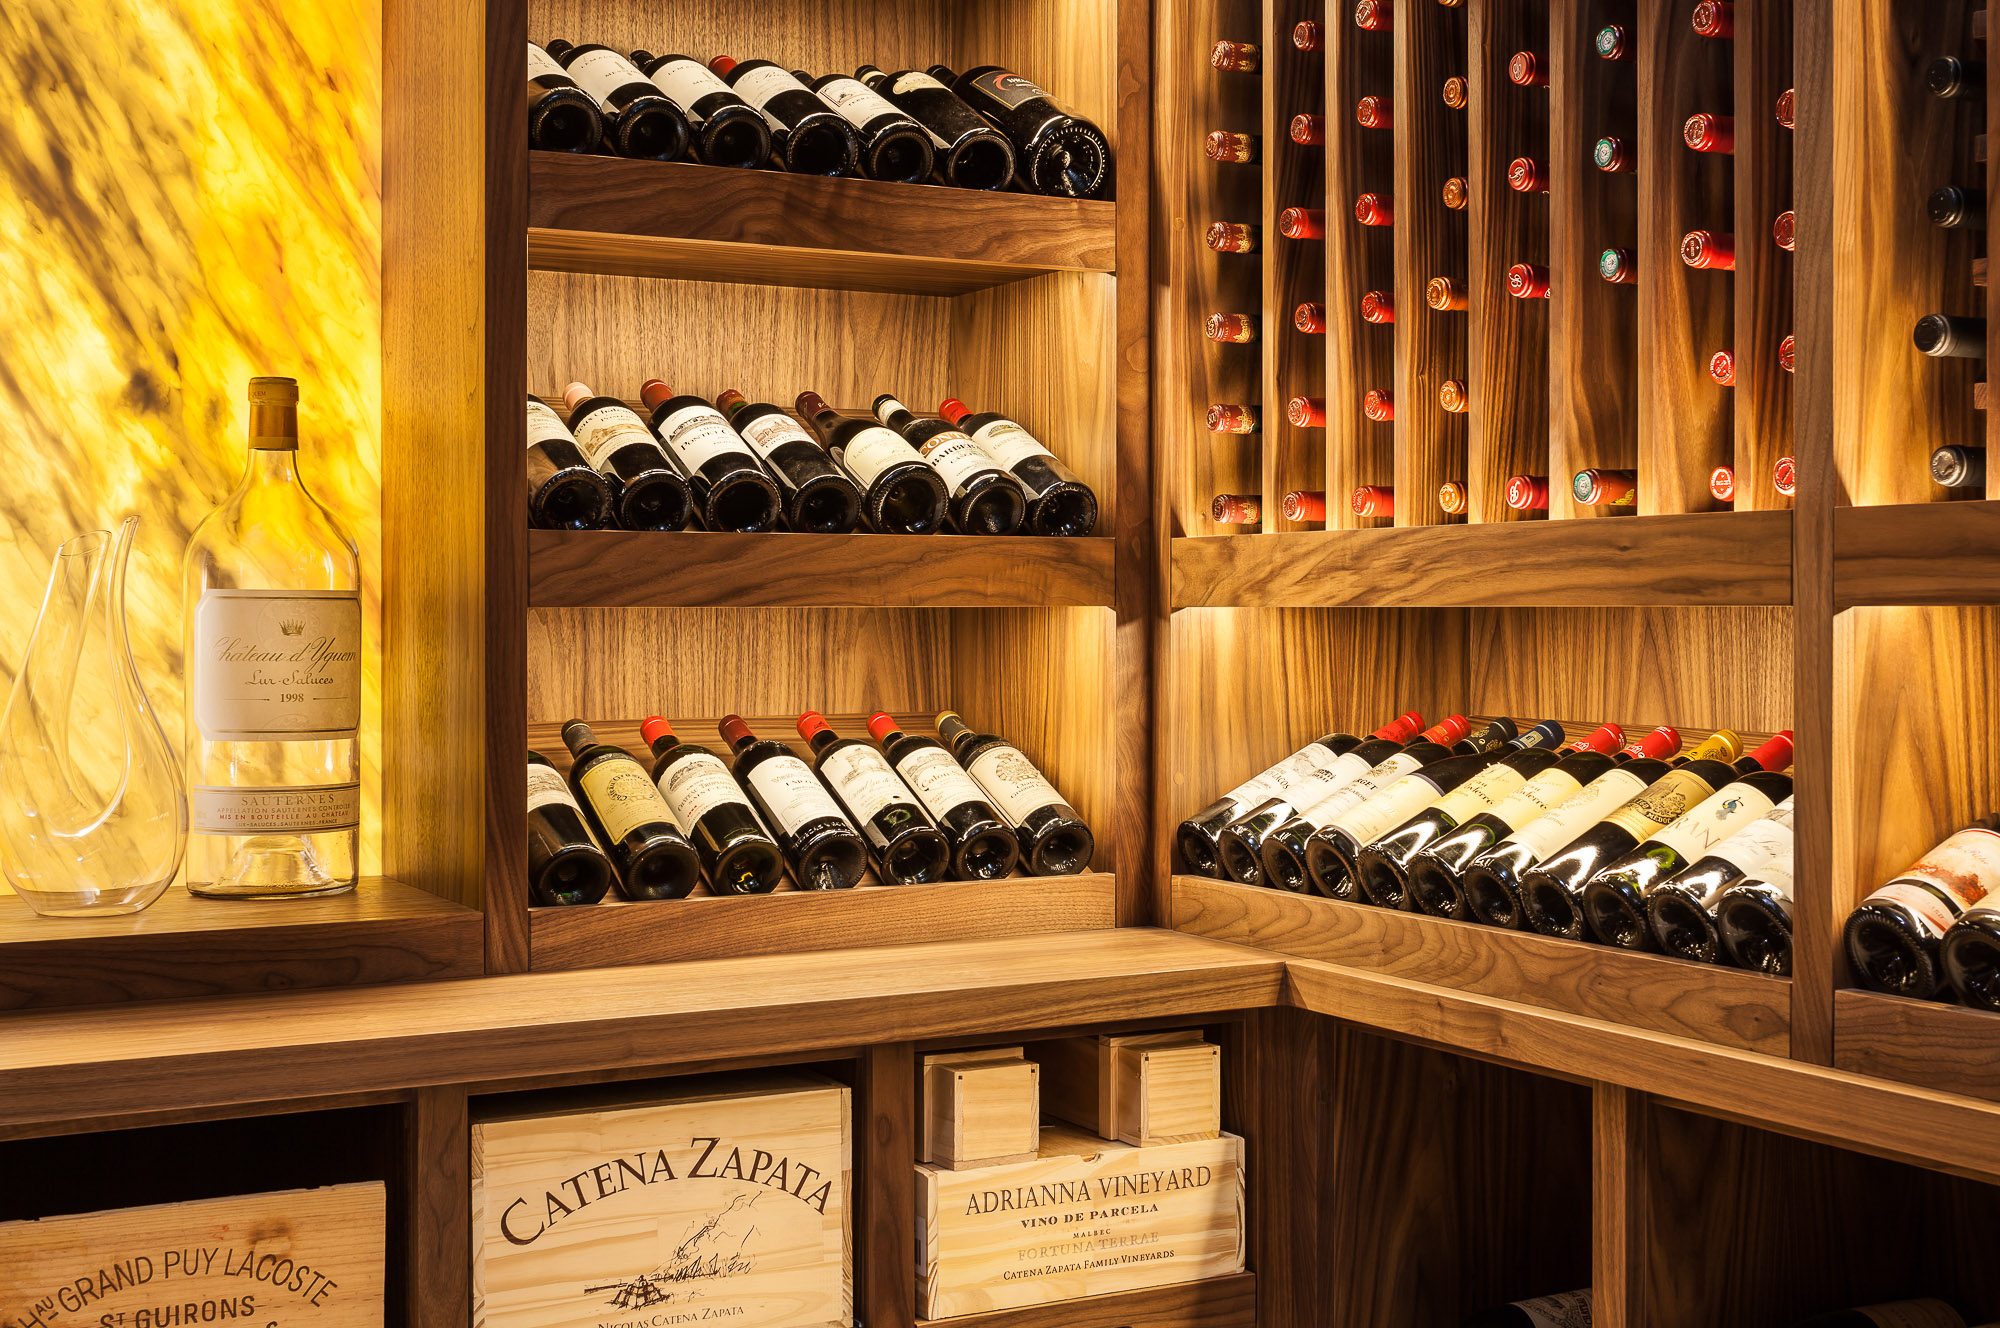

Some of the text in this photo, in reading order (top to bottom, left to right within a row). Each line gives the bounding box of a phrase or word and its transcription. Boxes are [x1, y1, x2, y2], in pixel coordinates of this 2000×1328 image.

[213, 637, 357, 675] Château d'Yquem
[280, 693, 304, 703] 1998
[241, 793, 335, 806] SAUTERNES
[500, 1137, 834, 1246] CATENA ZAPATA
[965, 1165, 1212, 1216] ADRIANNA VINEYARD
[1020, 1203, 1159, 1229] VINO DE PARCELA
[1018, 1231, 1160, 1261] FORTUNA TERRAE
[1072, 1228, 1112, 1240] MALBEC
[57, 1256, 154, 1313] GRAND
[164, 1247, 220, 1280] PUY
[223, 1248, 338, 1308] LACOSTE
[1003, 1249, 1175, 1281] CATENA ZAPATA FAMILY VINEYARDS
[135, 1295, 256, 1328] GUIRONS
[651, 1313, 698, 1327] CATENA
[701, 1305, 745, 1321] ZAPATA
